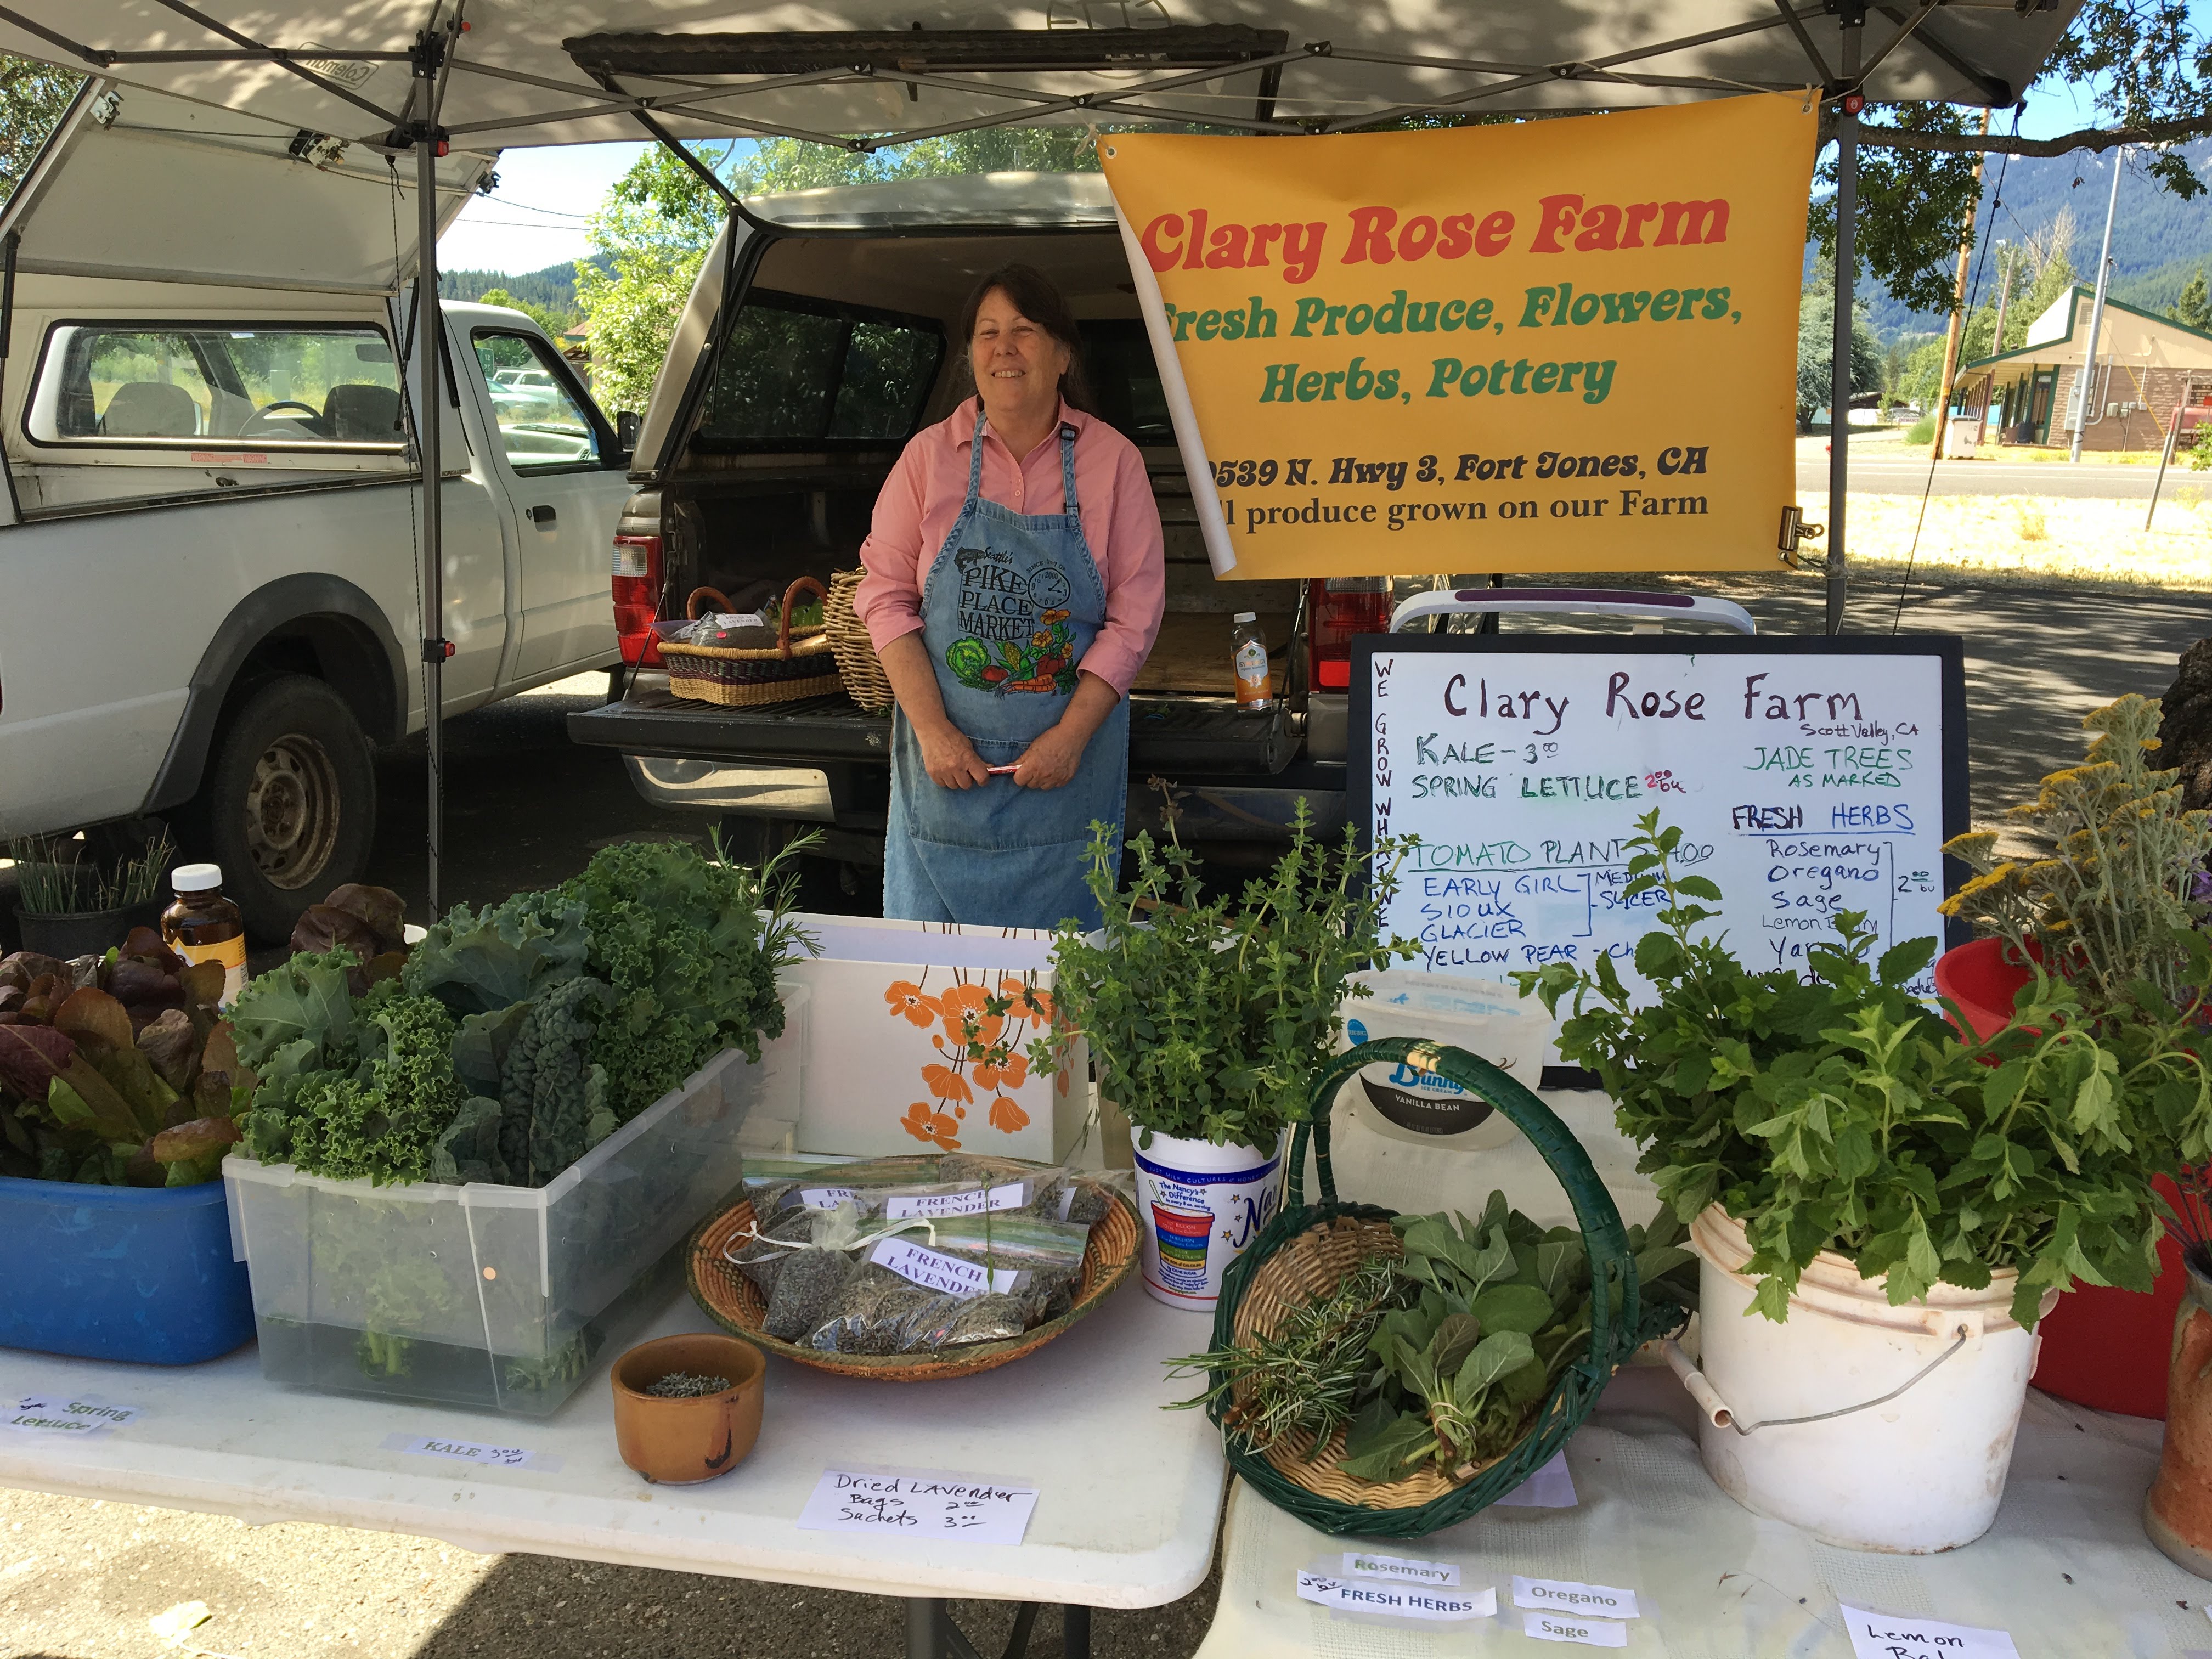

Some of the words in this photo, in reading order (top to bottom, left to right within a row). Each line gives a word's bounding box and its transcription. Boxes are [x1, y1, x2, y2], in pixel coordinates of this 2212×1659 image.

[1141, 208, 1327, 284] Clary
[1341, 205, 1516, 267] Rose
[1528, 194, 1730, 255] Farm
[1290, 289, 1505, 336] Produce,
[1517, 281, 1742, 327] Flowers,
[1259, 356, 1410, 405] Herbs,
[1425, 356, 1618, 405] Pottery
[191, 453, 214, 462] WARNING
[244, 454, 267, 463] WARNING
[1285, 459, 1318, 485] N.
[1328, 458, 1408, 491] Hwy
[1416, 455, 1444, 486] 3,
[1454, 454, 1528, 481] Fort
[1536, 451, 1645, 479] Jones,
[1657, 447, 1710, 476] CA
[1246, 498, 1377, 534] produce
[1387, 501, 1487, 531] grown
[1498, 500, 1539, 519] on
[1550, 498, 1609, 517] our
[1619, 490, 1709, 516] Farm
[984, 546, 1013, 564] Seattle's
[1026, 561, 1044, 573] SINCE
[963, 565, 1028, 595] PIKE
[960, 590, 1033, 616] PLACE
[960, 610, 1035, 641] MARKET
[1444, 674, 1570, 735] Clary
[1606, 672, 1706, 721] Rose
[1745, 673, 1863, 720] Farm
[1800, 723, 1851, 737] Scott
[1895, 723, 1919, 736] CA
[1375, 713, 1392, 787] GROW
[1416, 733, 1496, 766] KALE
[1743, 747, 1814, 771] JADE
[1824, 747, 1914, 770] TREES
[1412, 775, 1497, 799] SPRING
[1520, 775, 1643, 801] LETTUCE
[1788, 774, 1813, 788] AS
[1822, 771, 1901, 788] MARKED
[1733, 804, 1803, 831] FRESH
[1832, 802, 1915, 831] HERBS
[1408, 840, 1531, 867] TOMATO
[1766, 839, 1880, 865] Rosemary
[1424, 877, 1500, 899] EARLY
[1515, 875, 1581, 895] GIRL
[1768, 866, 1879, 890] Oregano
[1771, 891, 1843, 913] Sage
[1420, 919, 1526, 943] GLACIER
[1762, 915, 1822, 930] Lemon
[1424, 945, 1510, 974] YELLOW
[1525, 945, 1579, 962] PEAR
[1395, 1094, 1432, 1109] VANILLA
[1435, 1103, 1460, 1111] BEAN
[917, 1190, 987, 1206] FRENCH
[1159, 1181, 1171, 1189] The
[1172, 1183, 1199, 1197] Nancy's
[1169, 1191, 1205, 1204] Difference
[902, 1200, 1001, 1217] LAVENDER
[887, 1256, 979, 1293] LAVENDE
[906, 1248, 983, 1282] FRENCH
[62, 1402, 133, 1421] Spring
[422, 1442, 481, 1457] KALE
[834, 1474, 900, 1493] Dried
[850, 1494, 904, 1511] Bags
[838, 1508, 918, 1526] Sachets
[1354, 1559, 1451, 1581] Rosemary
[1341, 1589, 1401, 1606] FRESH
[1409, 1596, 1472, 1612] HERBS
[1532, 1587, 1618, 1607] Oregano
[1541, 1620, 1589, 1639] Sage
[1867, 1624, 1964, 1647] Lemon
